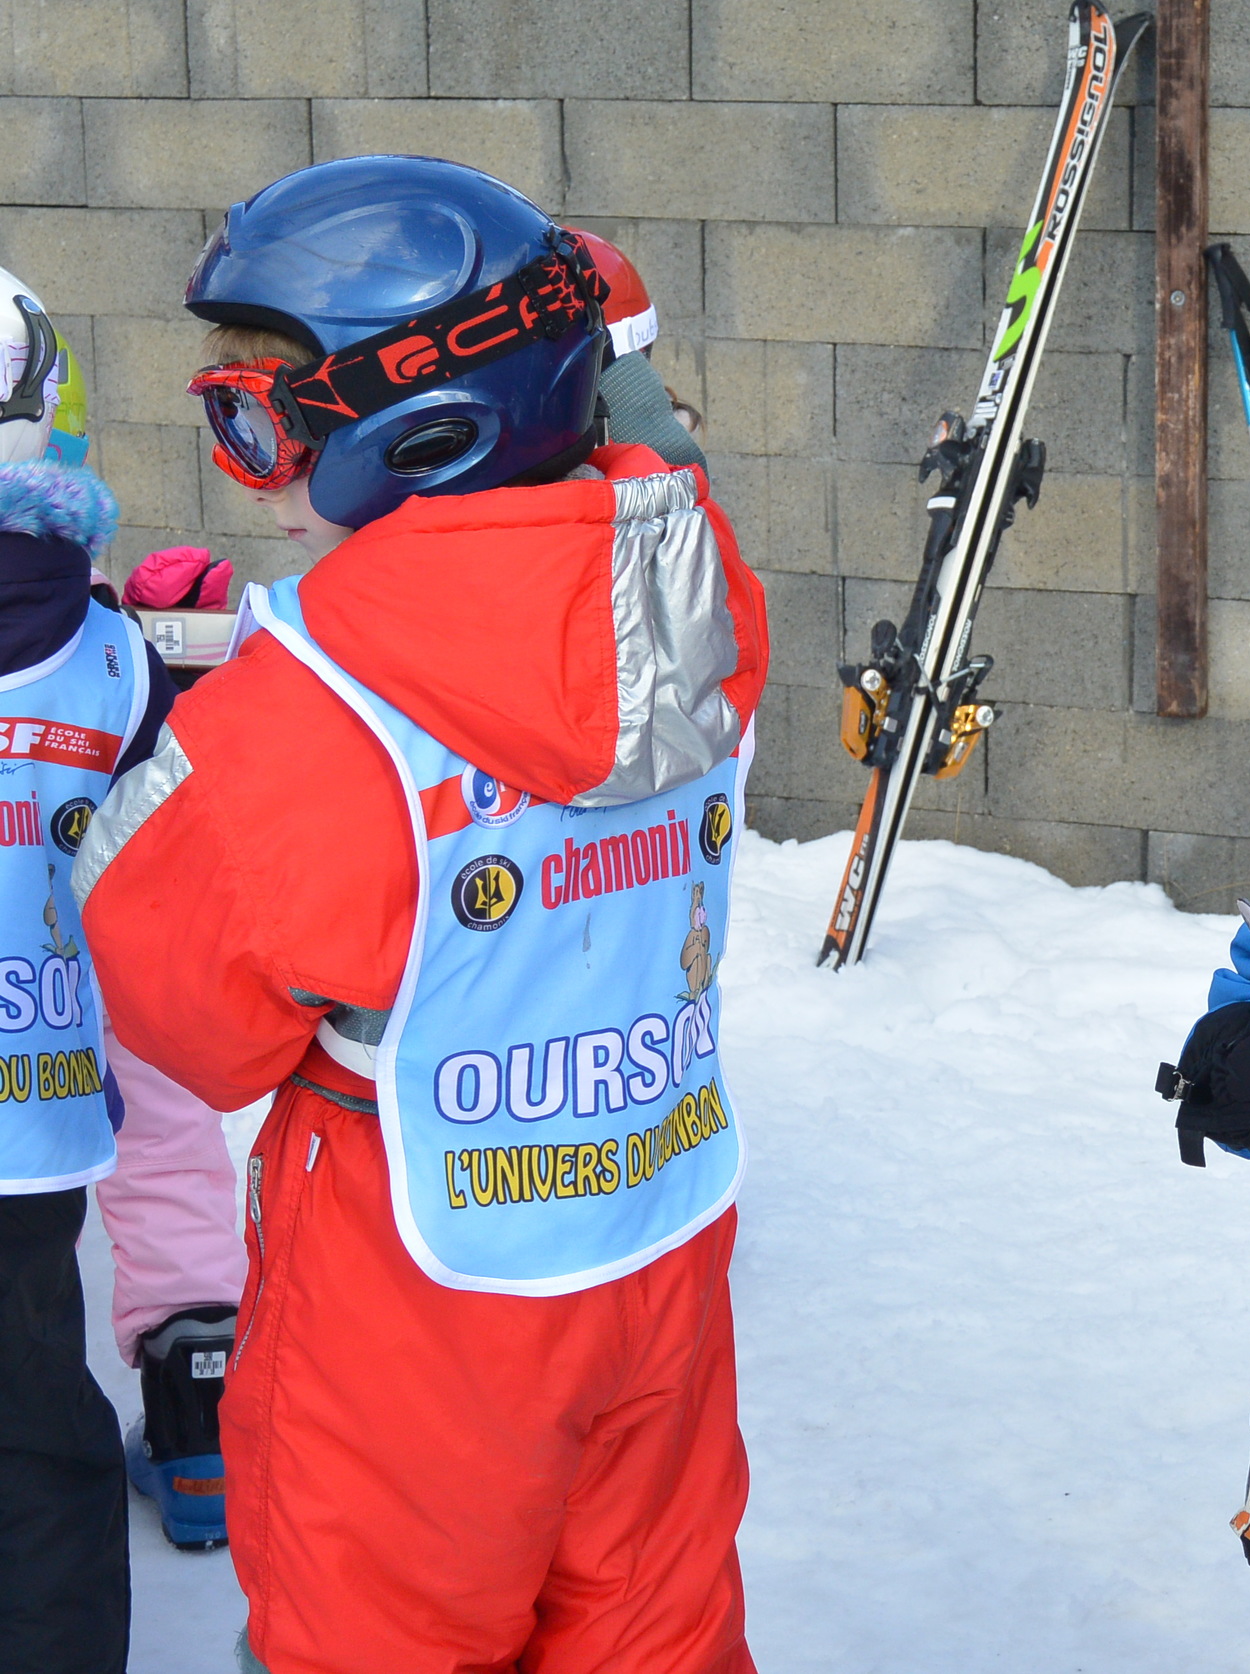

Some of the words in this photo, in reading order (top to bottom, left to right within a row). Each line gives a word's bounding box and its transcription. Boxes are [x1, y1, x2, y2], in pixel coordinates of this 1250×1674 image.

[1046, 22, 1108, 243] ROSSIGNOL
[47, 734, 64, 742] DU
[69, 739, 90, 747] SKI
[486, 857, 498, 866] de
[499, 857, 511, 868] ski
[541, 809, 691, 911] chamonix
[834, 855, 865, 931] WC
[445, 1138, 621, 1209] L'UNIVERS
